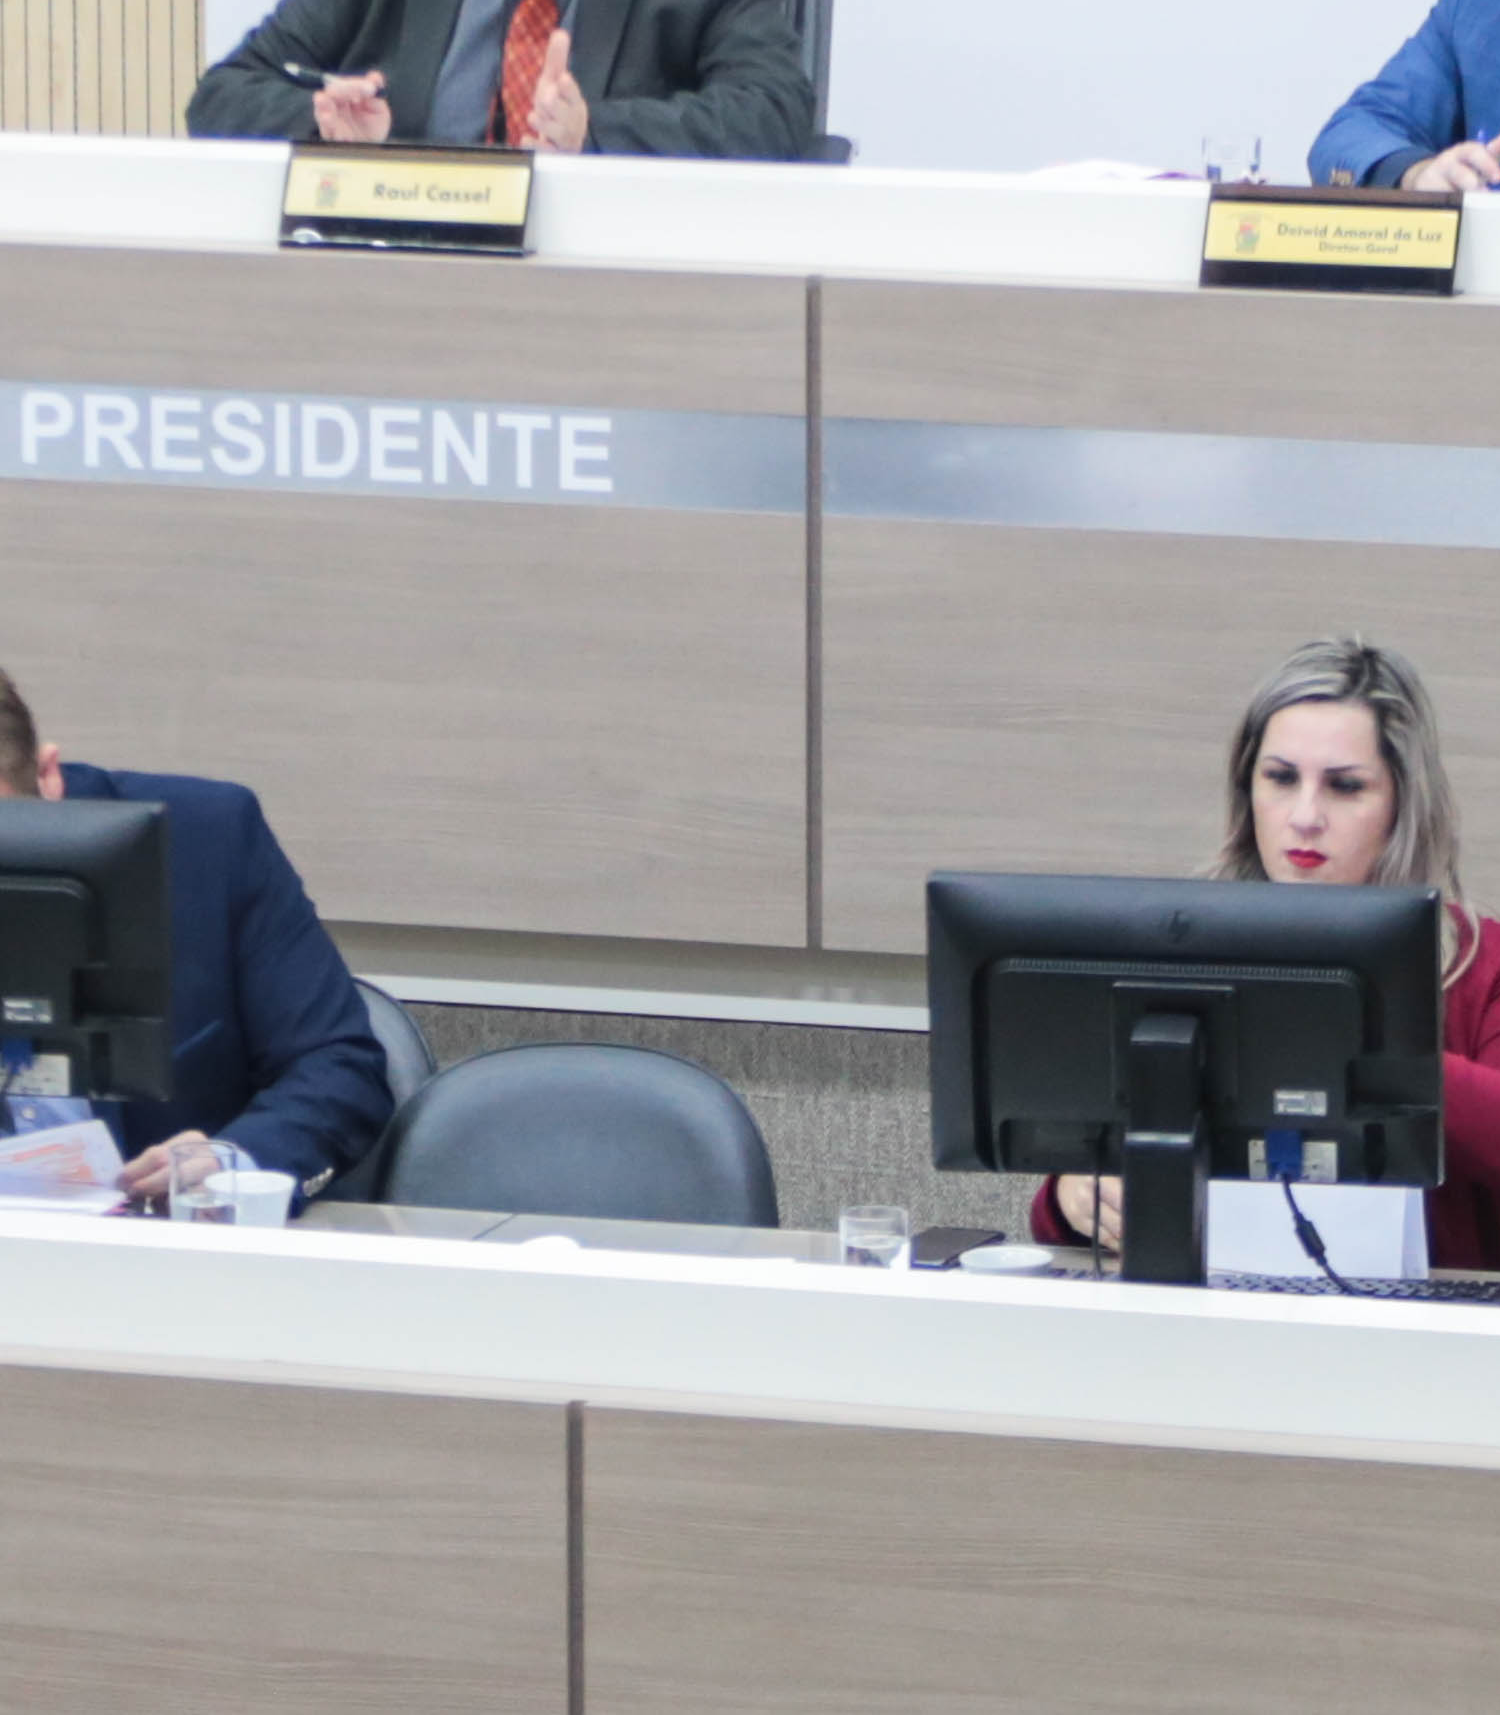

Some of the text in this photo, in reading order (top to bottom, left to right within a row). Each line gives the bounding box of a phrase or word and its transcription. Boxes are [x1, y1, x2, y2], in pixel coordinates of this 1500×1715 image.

[373, 183, 491, 204] Raul Cassel
[20, 390, 616, 493] PRESIDENTE
